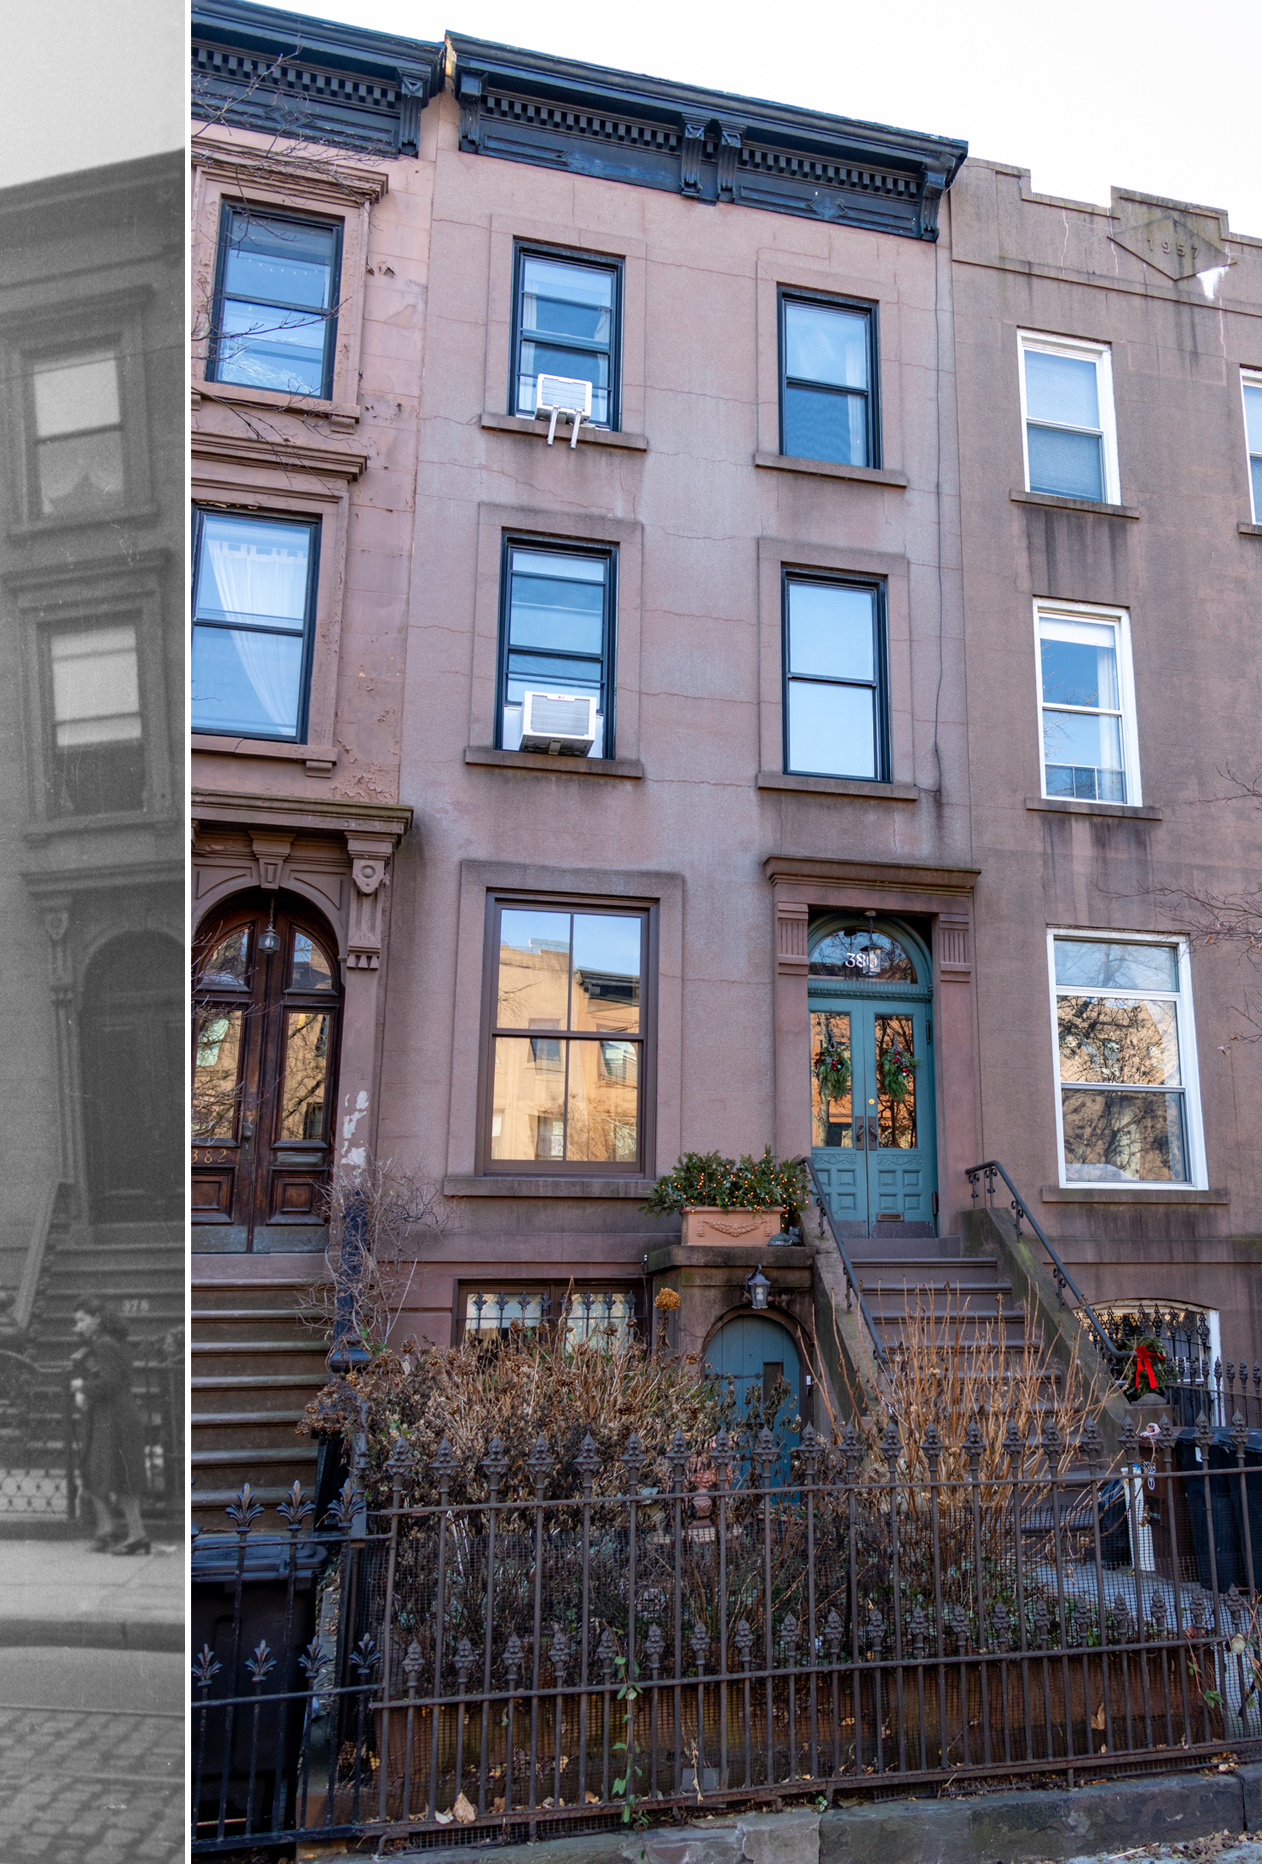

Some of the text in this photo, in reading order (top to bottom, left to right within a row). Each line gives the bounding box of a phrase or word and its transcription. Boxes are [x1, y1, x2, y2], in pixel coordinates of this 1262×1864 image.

[1147, 238, 1199, 260] 1957
[845, 952, 877, 968] 380
[191, 1148, 227, 1164] 382
